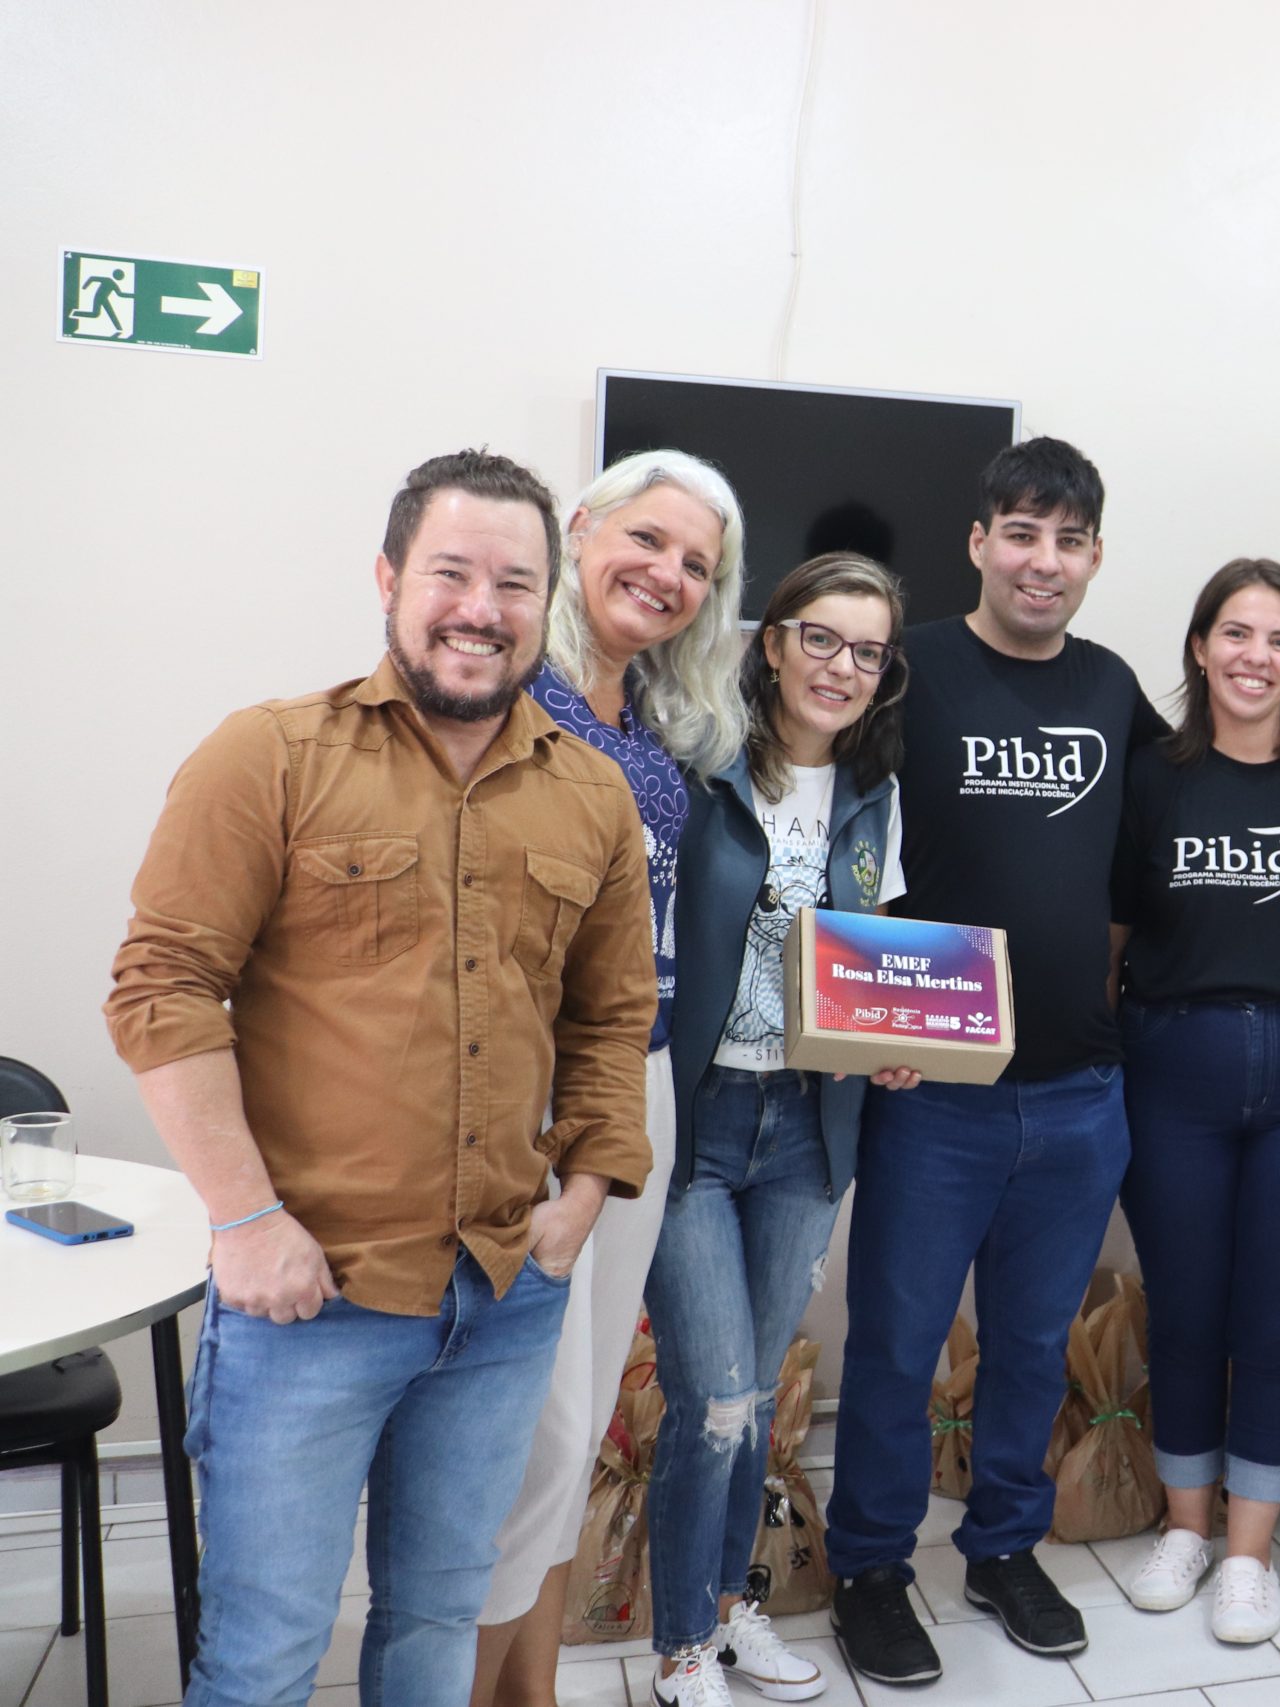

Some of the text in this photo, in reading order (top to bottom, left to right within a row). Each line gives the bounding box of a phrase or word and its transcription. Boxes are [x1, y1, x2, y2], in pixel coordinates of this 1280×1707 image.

[961, 736, 1085, 782] Pibid
[964, 779, 1007, 787] PROGRAMA
[1008, 780, 1060, 790] INSTITUCIONAL
[998, 788, 1034, 797] INICIAÇÃO
[1042, 790, 1076, 799] DOCÊNCIA
[1173, 872, 1214, 880] PROGRAMA
[1215, 873, 1267, 881] INSTITUCIONAL
[1169, 879, 1192, 888] BOLSA
[1205, 878, 1241, 887] INICIAÇÃO
[882, 953, 932, 972] EMEF
[832, 963, 983, 992] Rosa Elsa Mertins
[855, 1007, 881, 1019] Pibid
[965, 1026, 996, 1035] FACCAT
